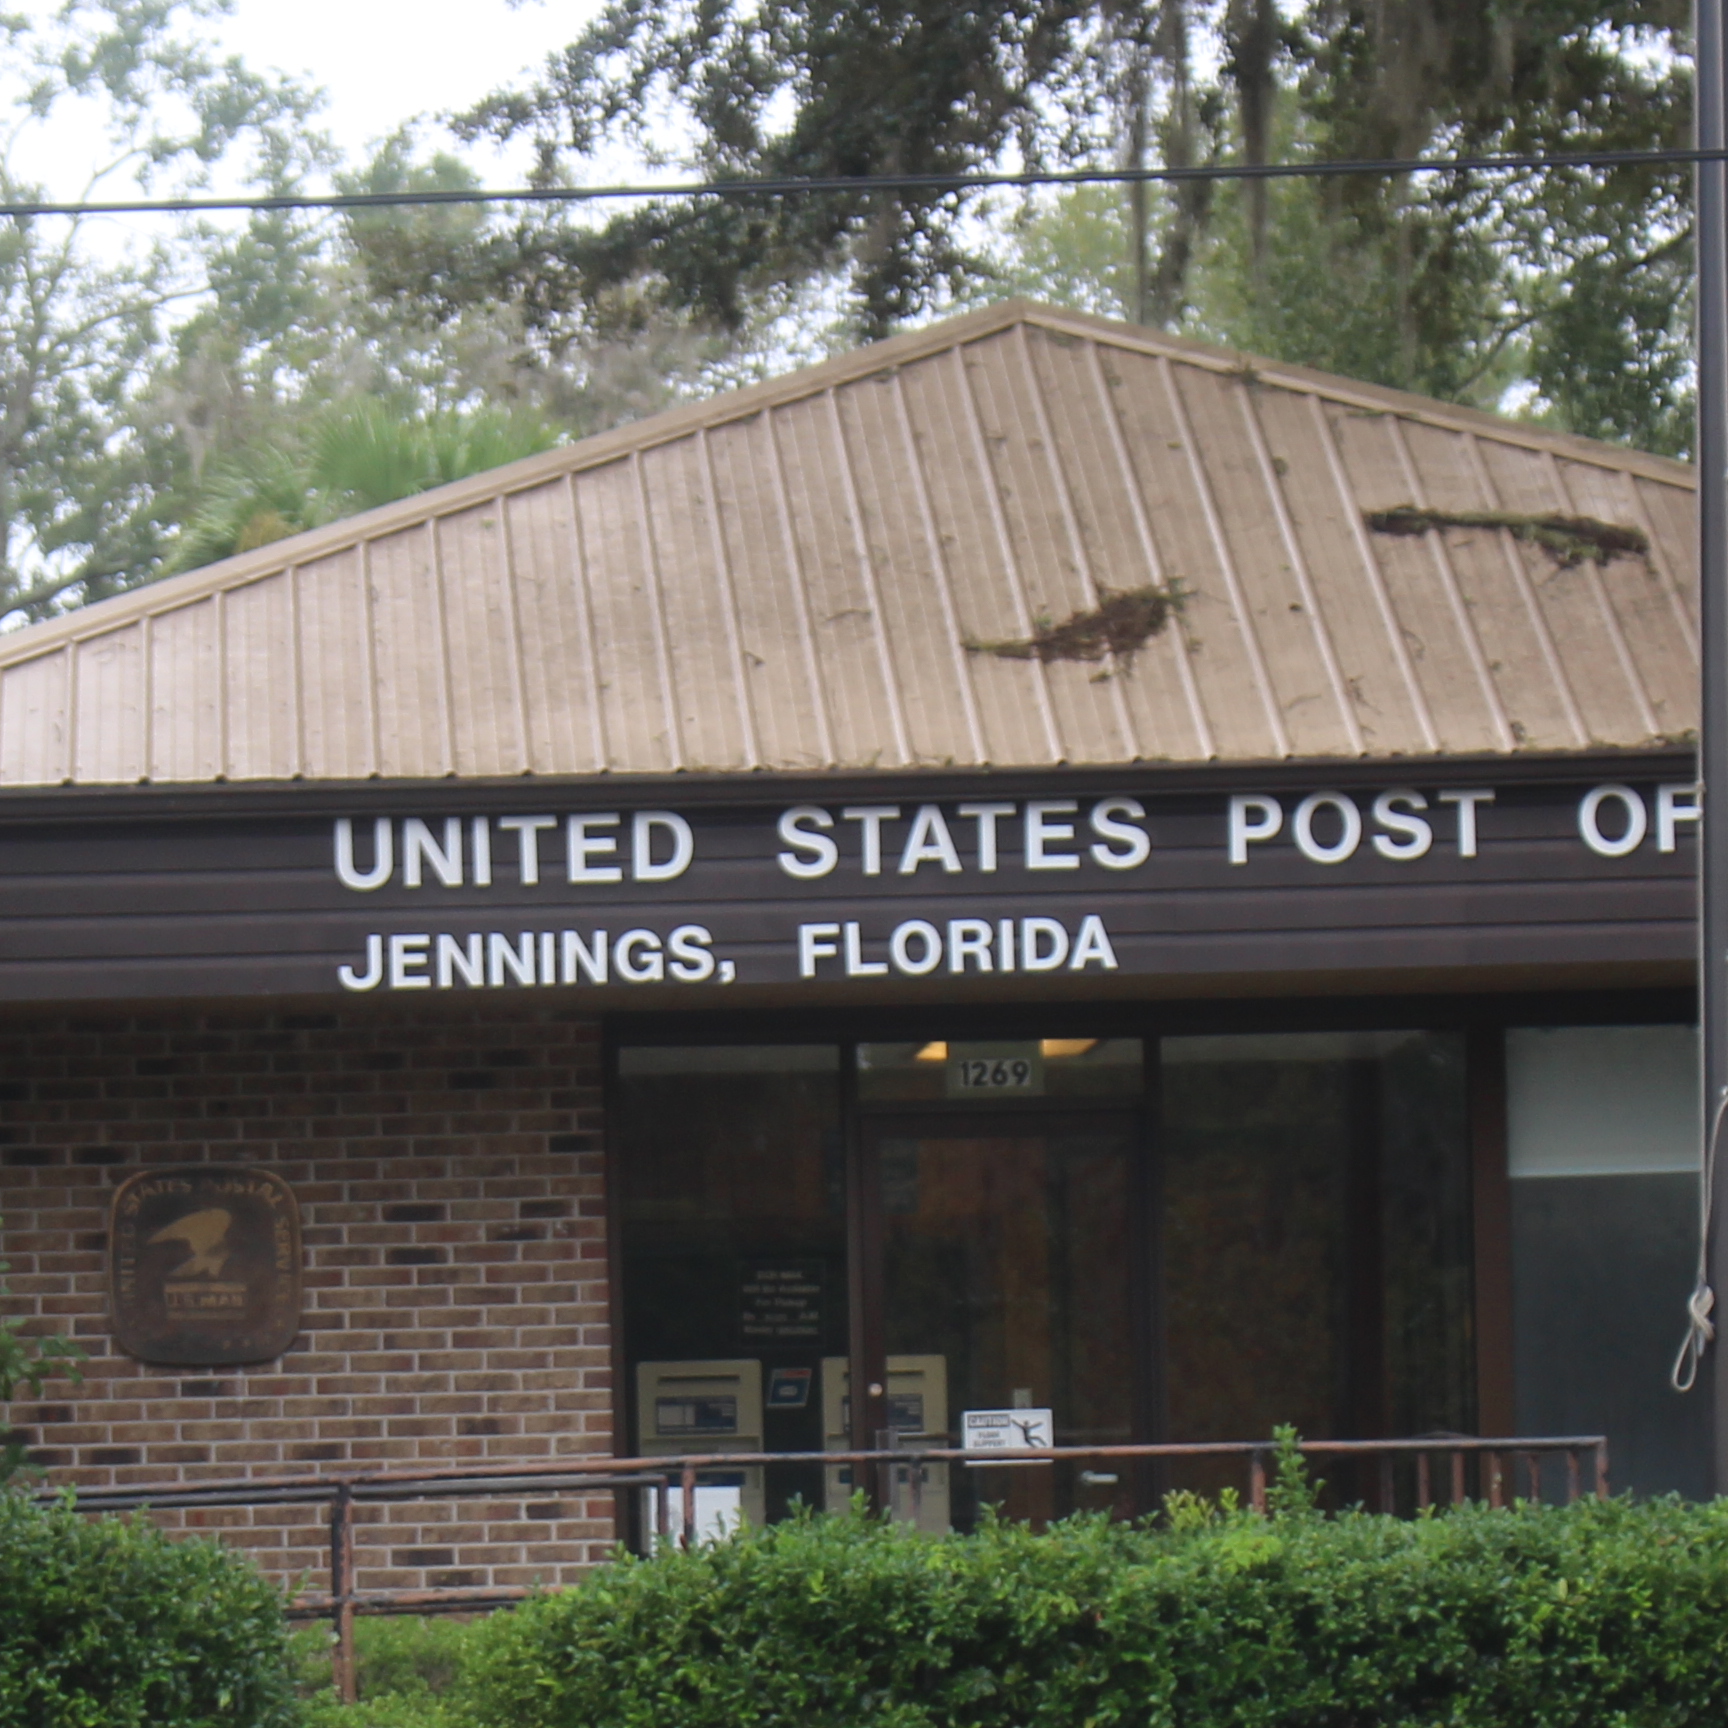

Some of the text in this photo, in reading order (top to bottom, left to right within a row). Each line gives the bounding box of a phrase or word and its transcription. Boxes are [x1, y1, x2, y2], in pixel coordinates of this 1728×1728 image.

[333, 811, 695, 891] UNITED
[776, 799, 1152, 880] STATES
[1227, 789, 1496, 866] POST
[336, 924, 737, 992] JENNINGS,
[797, 915, 1119, 979] FLORIDA
[961, 1061, 1029, 1087] 1269
